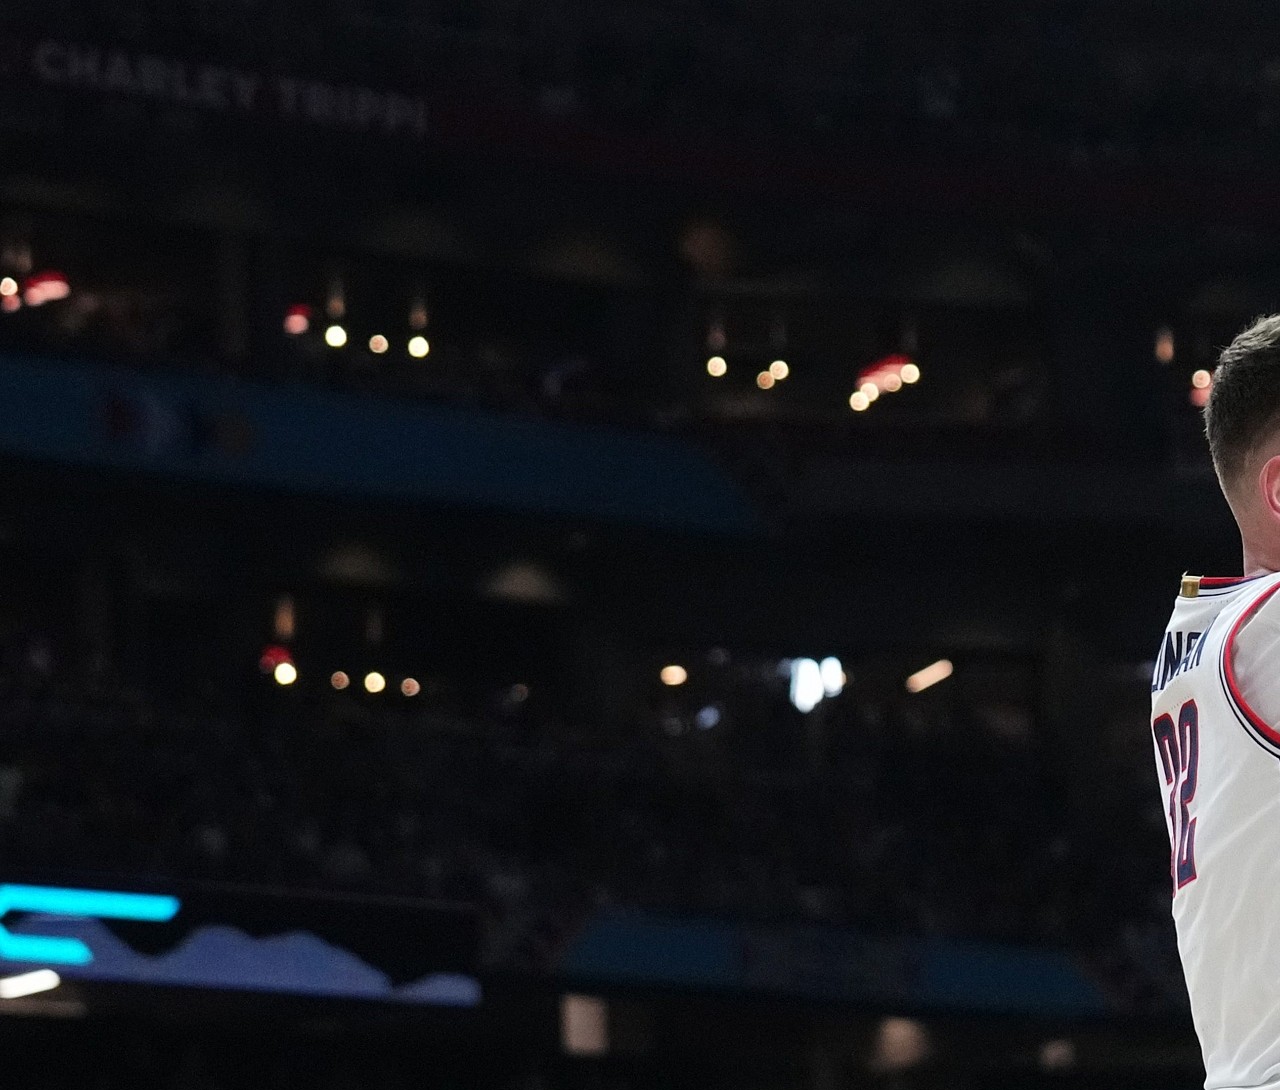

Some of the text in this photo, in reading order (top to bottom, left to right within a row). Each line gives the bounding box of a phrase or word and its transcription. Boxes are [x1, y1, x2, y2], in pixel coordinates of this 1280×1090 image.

[34, 39, 429, 140] CHARLEY TRIPPI
[1153, 698, 1199, 898] 32
